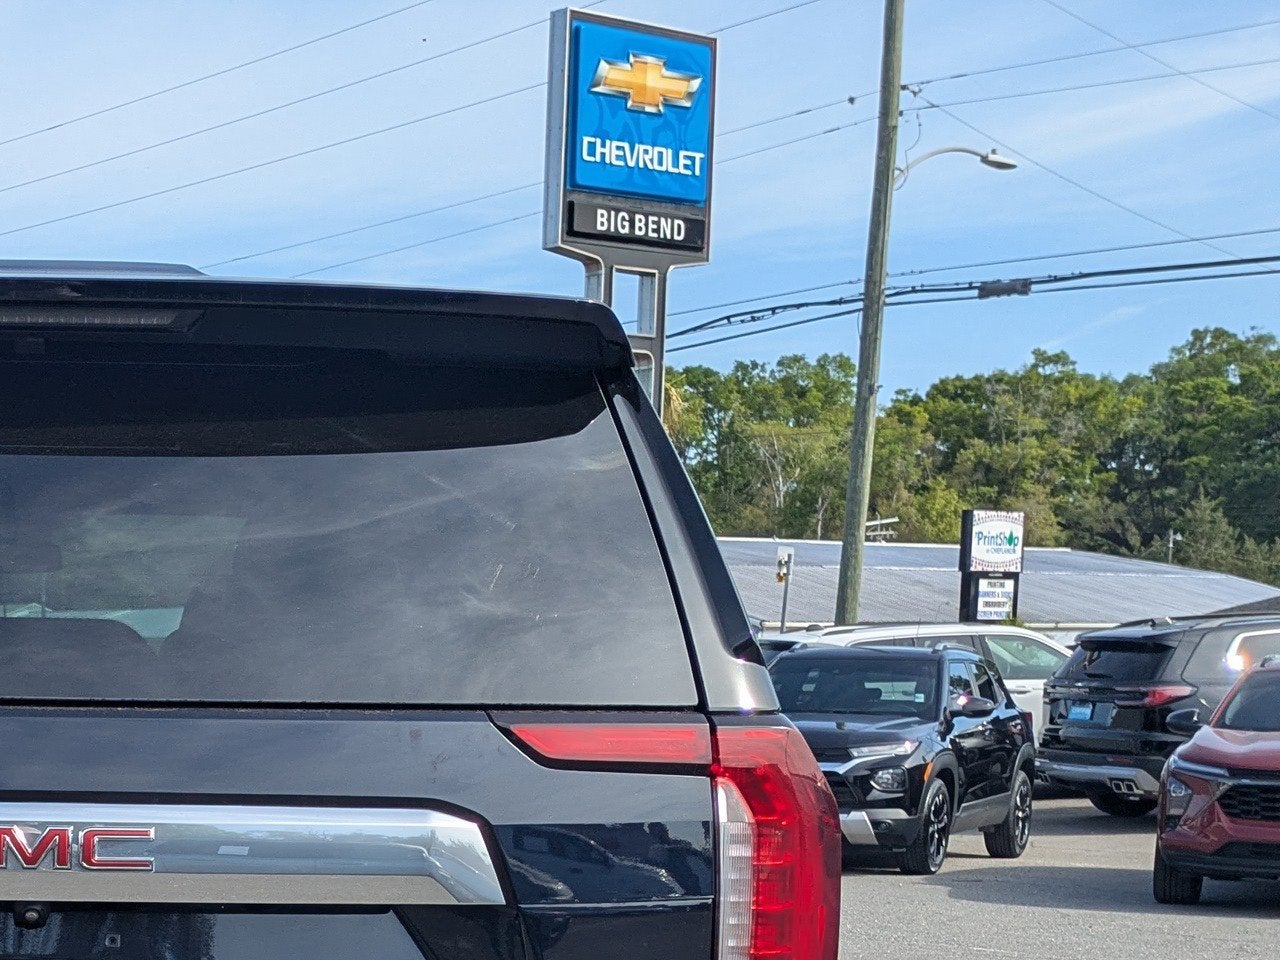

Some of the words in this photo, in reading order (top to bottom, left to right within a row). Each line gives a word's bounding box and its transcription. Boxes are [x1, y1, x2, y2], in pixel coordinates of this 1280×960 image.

[582, 136, 705, 176] CHEVROLET
[596, 209, 630, 234] BIG
[634, 214, 685, 241] BEND
